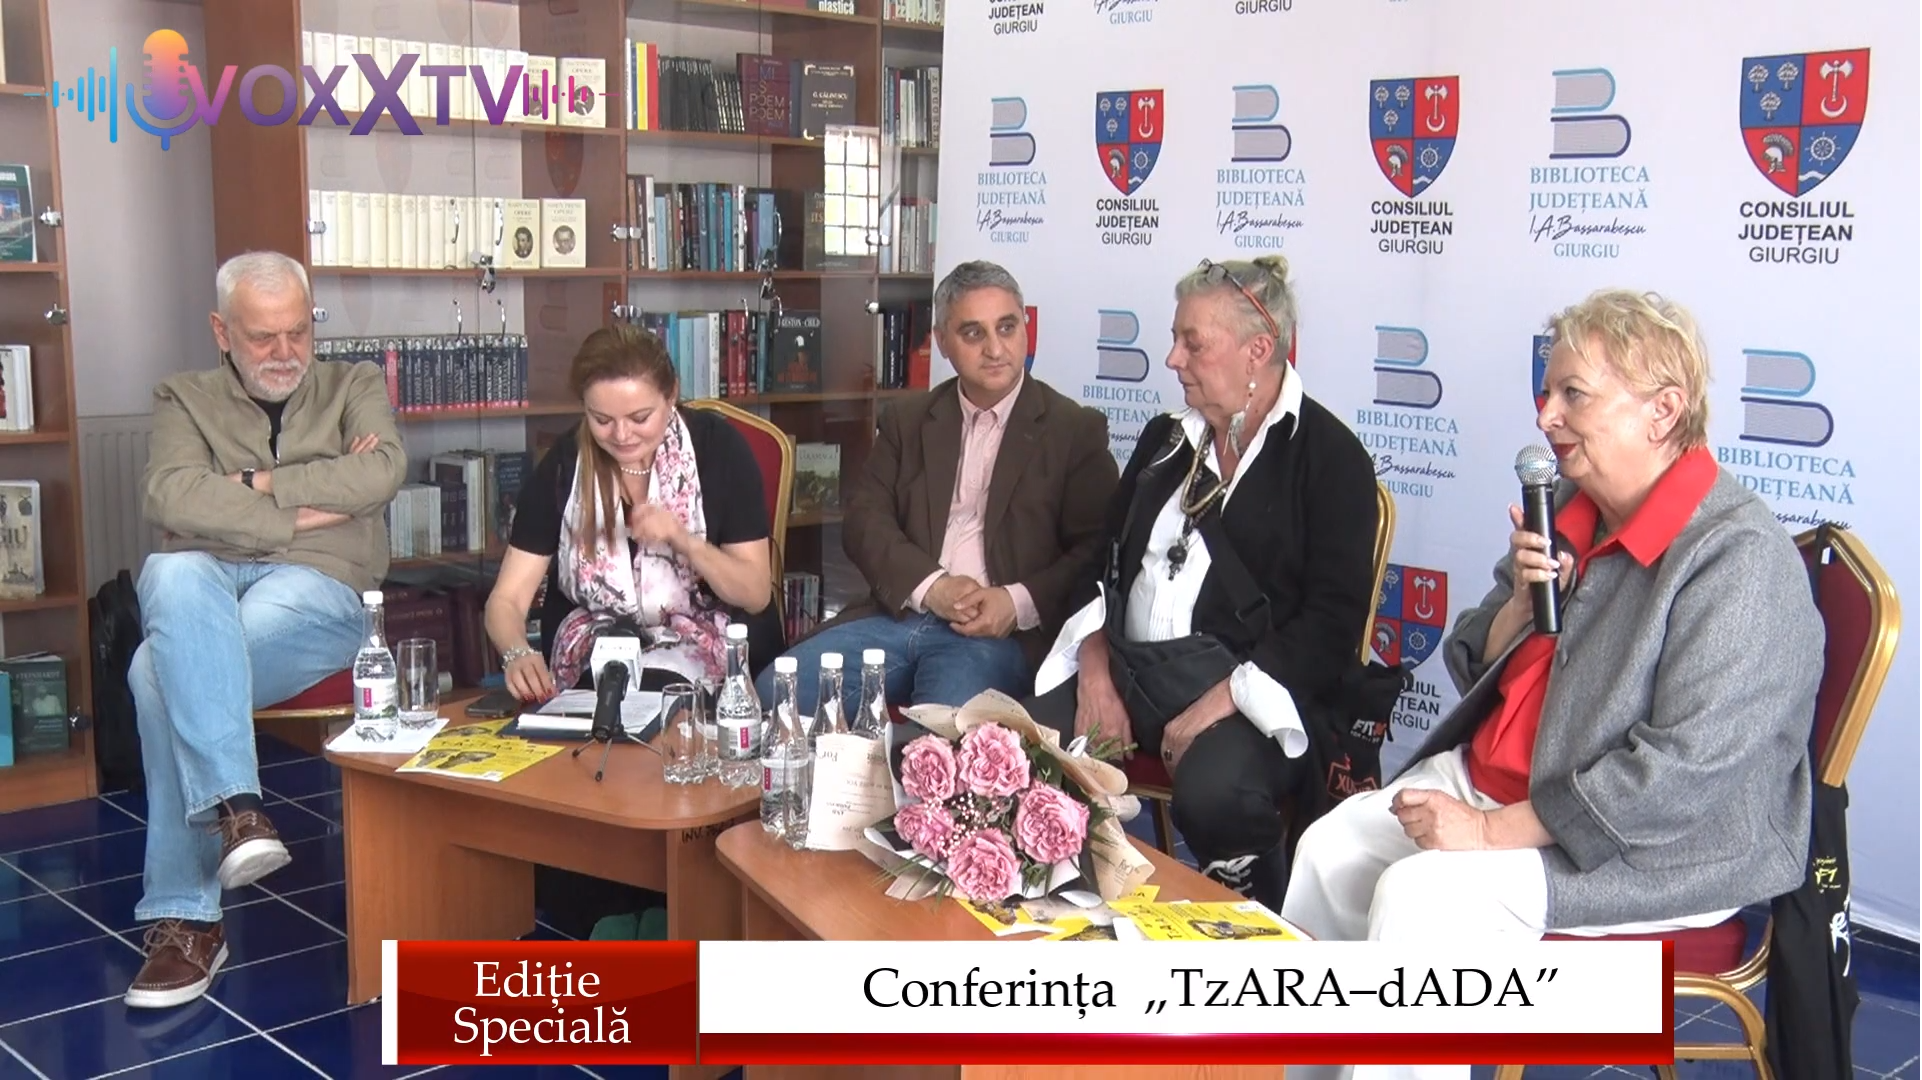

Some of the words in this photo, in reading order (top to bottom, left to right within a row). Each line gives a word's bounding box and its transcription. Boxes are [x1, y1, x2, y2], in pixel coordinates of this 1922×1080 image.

[988, 3, 1044, 20] JUDEȚEAN
[1235, 0, 1292, 15] GIURGIU
[1109, 10, 1153, 24] GIURGIU
[993, 19, 1038, 35] GIURGIU
[978, 171, 1047, 186] BIBLIOTECA
[1216, 168, 1305, 184] BIBLIOTECA
[1529, 165, 1650, 184] BIBLIOTECA
[977, 188, 1046, 208] JUDEȚEANĂ
[1096, 199, 1160, 212] CONSILIUL
[1216, 188, 1305, 209] JUDEȚEANĂ
[1528, 188, 1649, 214] JUDEȚEANĂ
[1371, 201, 1453, 216] CONSILIUL
[1739, 201, 1855, 218] CONSILIUL
[1095, 215, 1159, 231] JUDEȚEAN
[1370, 219, 1452, 238] JUDEȚEAN
[990, 231, 1030, 243] GIURGIU
[1101, 231, 1152, 245] GIURGIU
[1234, 235, 1284, 249] GIURGIU
[1738, 223, 1853, 246] JUDEȚEAN
[1378, 239, 1444, 255] GIURGIU
[1553, 242, 1620, 258] GIURGIU
[1749, 246, 1840, 264] GIURGIU
[1082, 385, 1161, 404] BIBLIOTECA
[1097, 406, 1158, 424] DEȚEAN
[1356, 409, 1459, 434] BIBLIOTECA
[1717, 446, 1857, 478] BIBLIOTECA
[1381, 479, 1434, 498] IURGIU
[1735, 474, 1855, 506] DEȚEANĂ
[1392, 711, 1431, 731] RGIU
